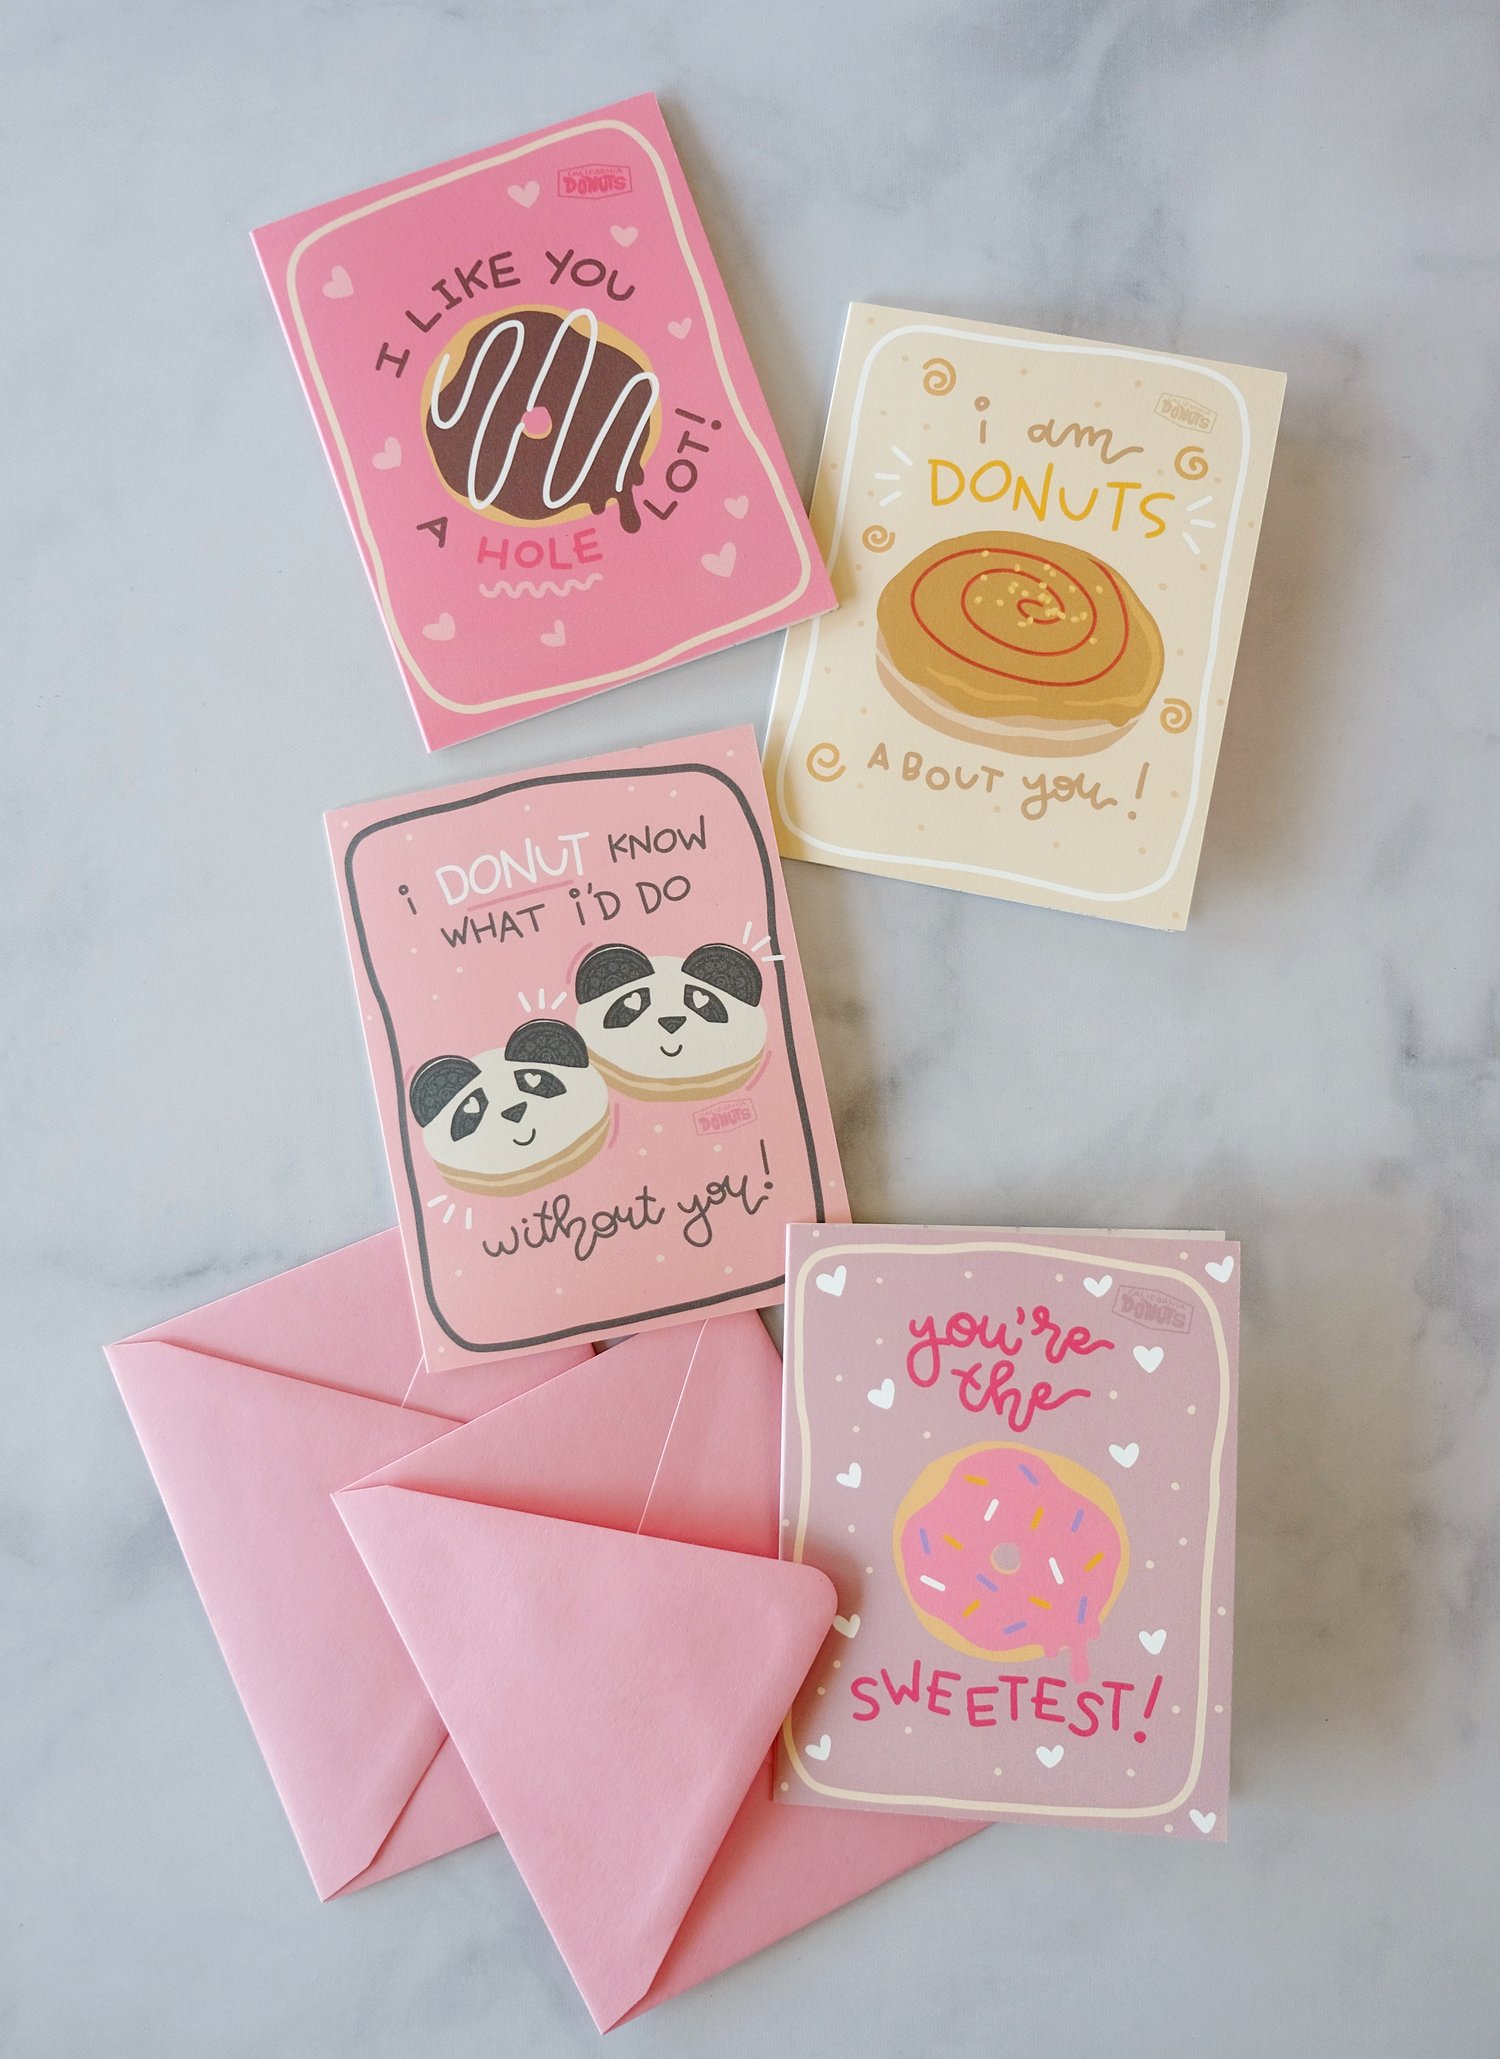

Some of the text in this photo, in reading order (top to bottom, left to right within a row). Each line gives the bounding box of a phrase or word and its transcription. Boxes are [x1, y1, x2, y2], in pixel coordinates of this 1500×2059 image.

[562, 173, 627, 194] DONUTS
[375, 249, 636, 378] I LIKE YOU
[974, 396, 1144, 464] i am
[1160, 398, 1210, 429] DONUTS
[416, 407, 722, 570] A HOLE LOT!
[928, 459, 1176, 539] DONUTS
[867, 742, 1004, 793] ABOUT
[398, 815, 706, 915] i DONUT KNOW
[440, 903, 545, 948] WHAT
[636, 875, 691, 914] DO
[698, 1107, 752, 1131] DONUTS
[482, 1185, 665, 1261] without
[906, 1305, 1115, 1388] you're
[1121, 1293, 1186, 1329] DONUTS
[950, 1360, 1091, 1433] the
[850, 1659, 1163, 1743] SWEETEST!
